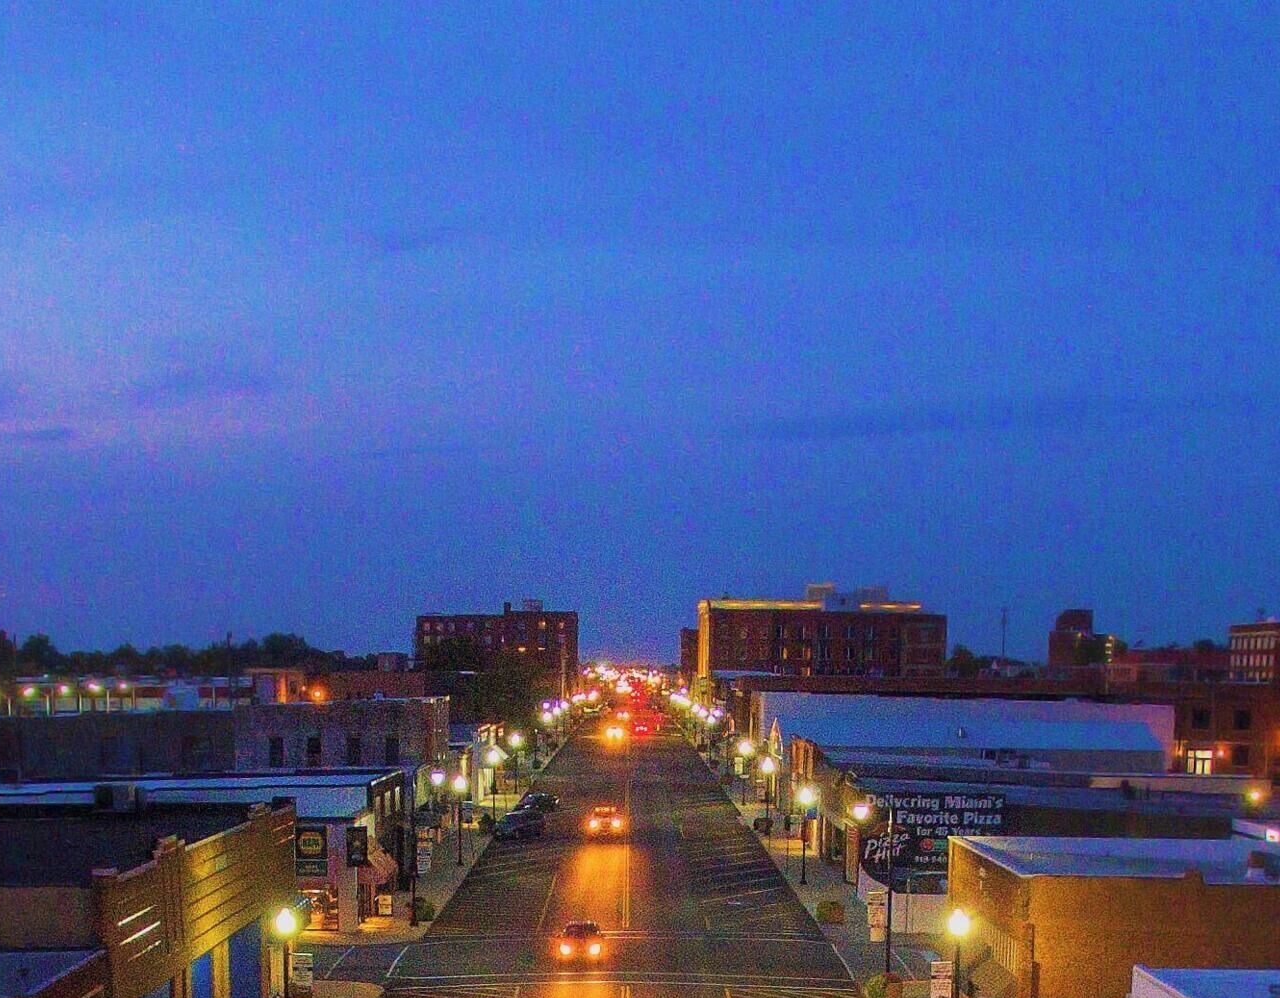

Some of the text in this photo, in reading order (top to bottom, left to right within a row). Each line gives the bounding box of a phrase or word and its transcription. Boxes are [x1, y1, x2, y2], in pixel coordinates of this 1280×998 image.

[865, 794, 1003, 810] Delivering Miami's
[896, 811, 1002, 825] Favorite Pizza
[916, 827, 932, 836] for
[865, 833, 910, 859] Pizza
